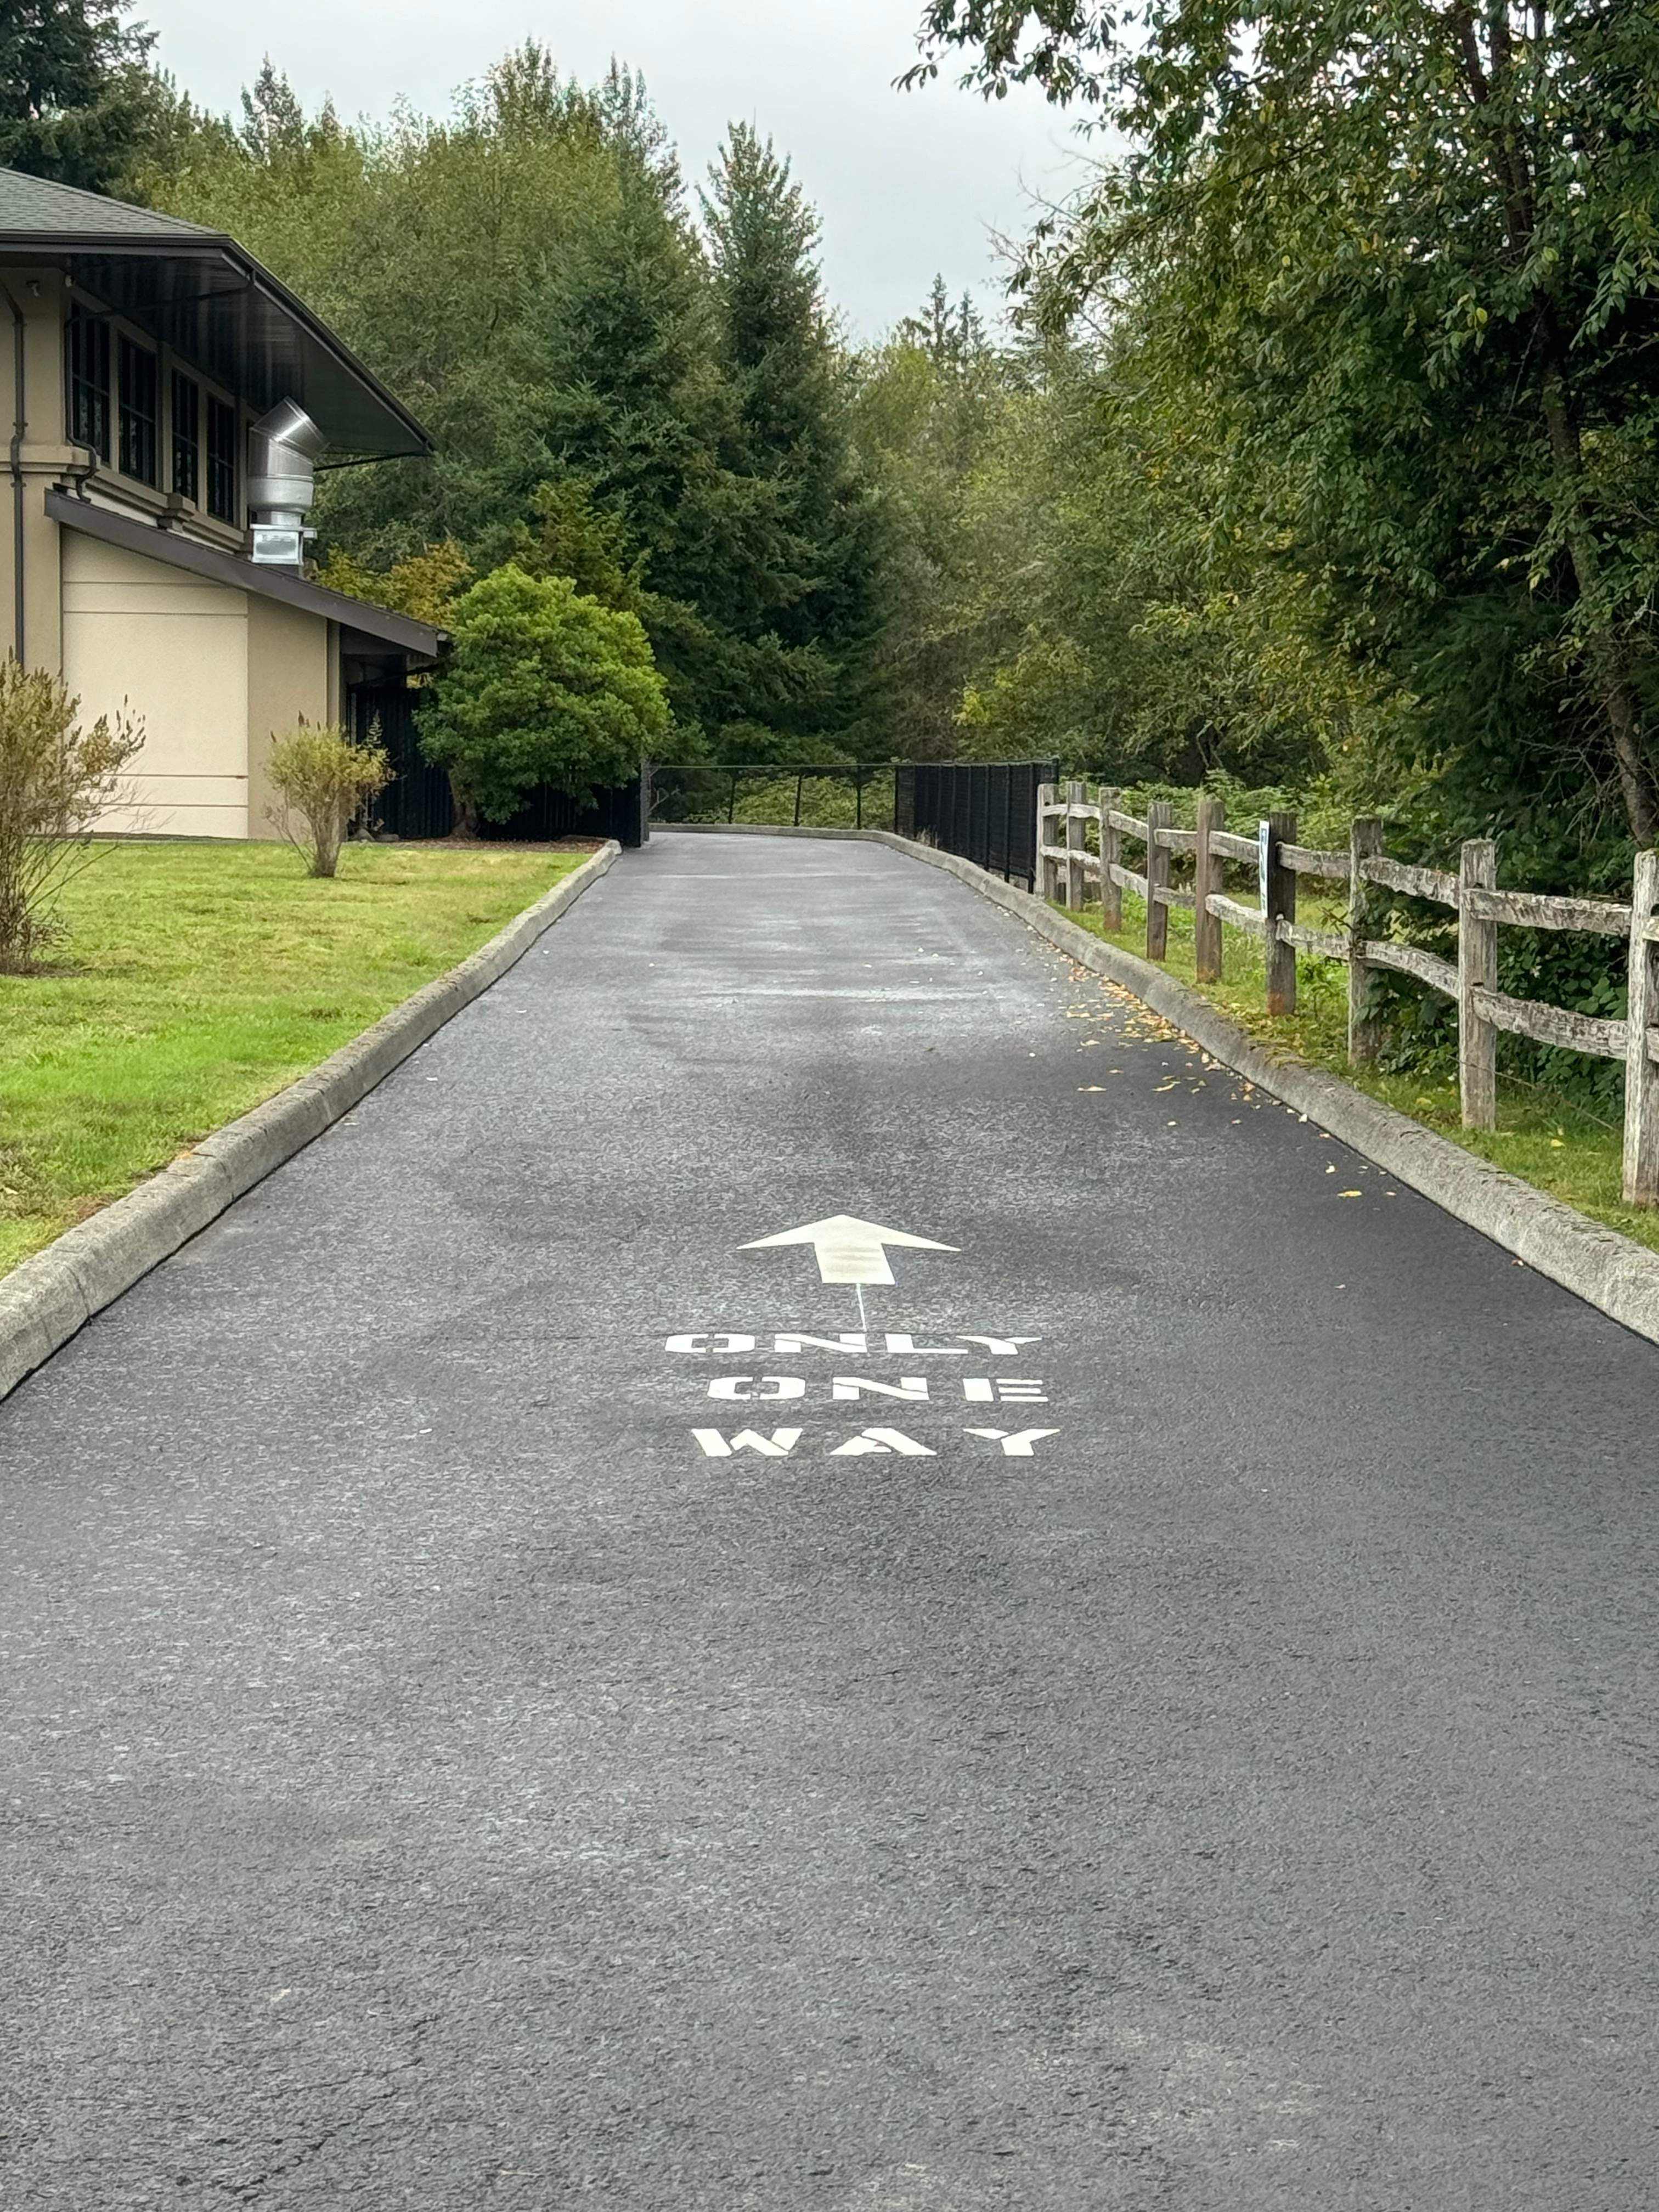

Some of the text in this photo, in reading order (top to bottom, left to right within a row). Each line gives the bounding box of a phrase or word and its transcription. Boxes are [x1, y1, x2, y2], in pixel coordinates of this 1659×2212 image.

[665, 1334, 1042, 1355] ONLY
[707, 1376, 1048, 1402] ONE
[691, 1427, 1060, 1457] WAY
